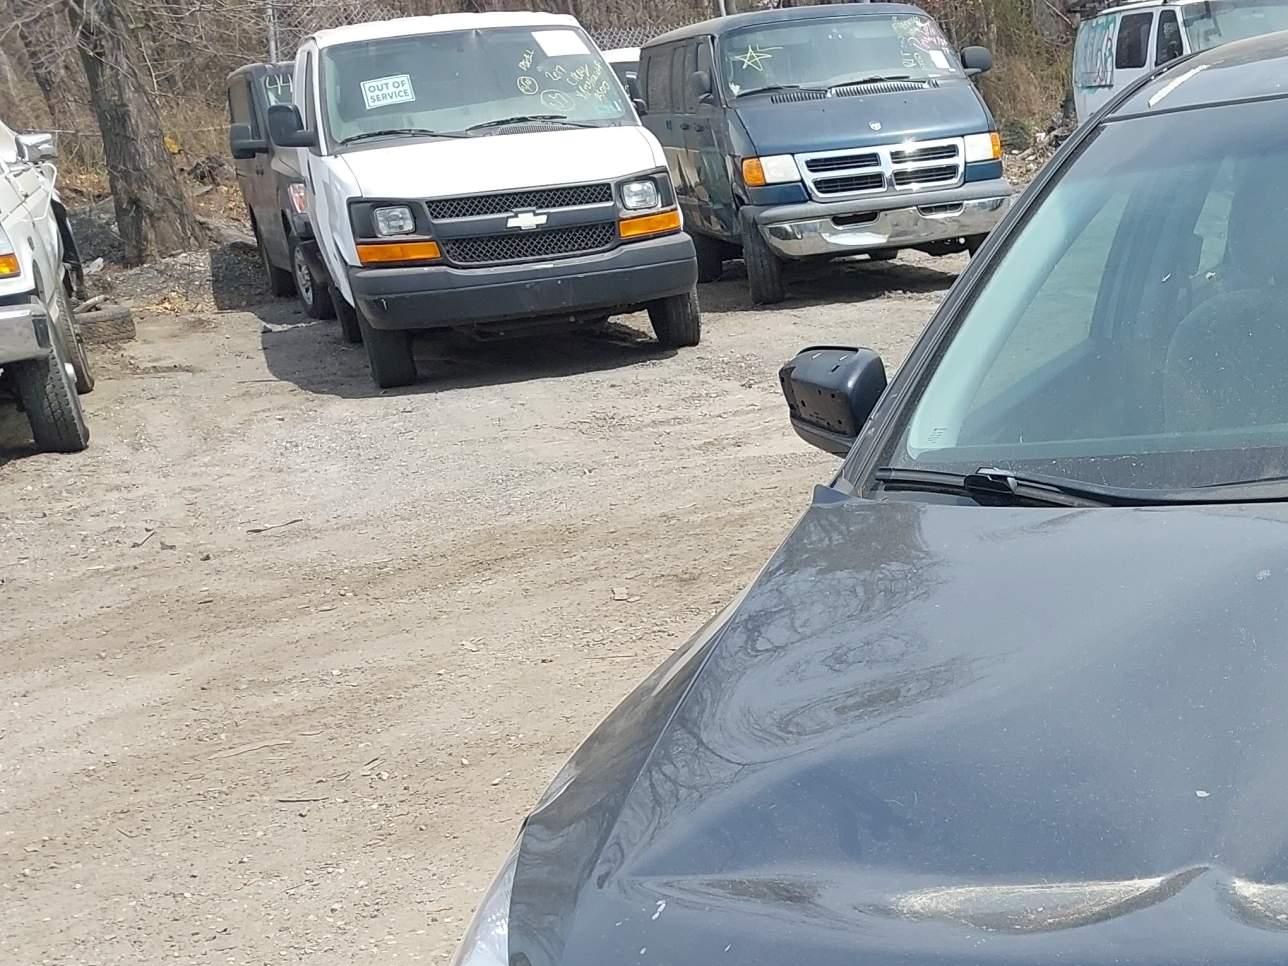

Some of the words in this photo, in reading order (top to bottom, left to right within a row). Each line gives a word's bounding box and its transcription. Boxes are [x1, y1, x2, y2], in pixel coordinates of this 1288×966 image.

[368, 82, 389, 93] OUT
[392, 80, 406, 89] OF
[370, 89, 410, 103] SERVICE
